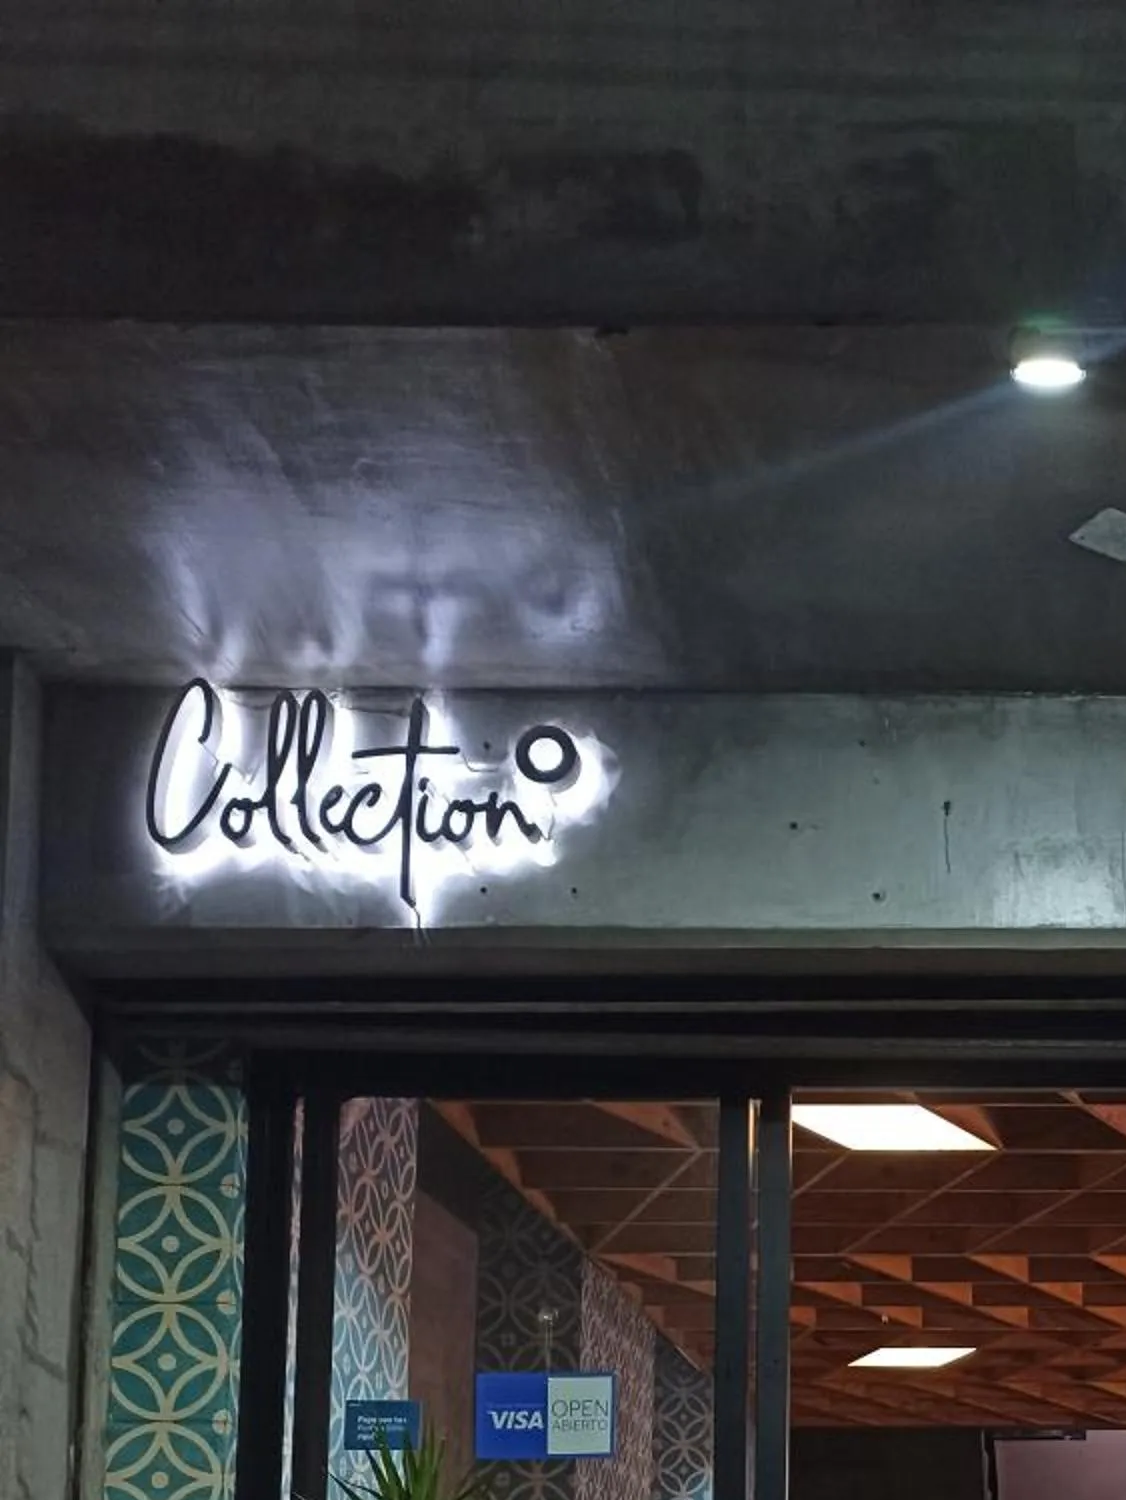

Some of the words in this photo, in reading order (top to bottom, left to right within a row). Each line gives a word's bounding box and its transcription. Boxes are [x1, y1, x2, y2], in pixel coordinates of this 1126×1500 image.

[146, 677, 542, 910] Collection
[551, 1399, 609, 1418] OPEN
[487, 1410, 544, 1431] VISA
[551, 1419, 609, 1431] ABIERTO
